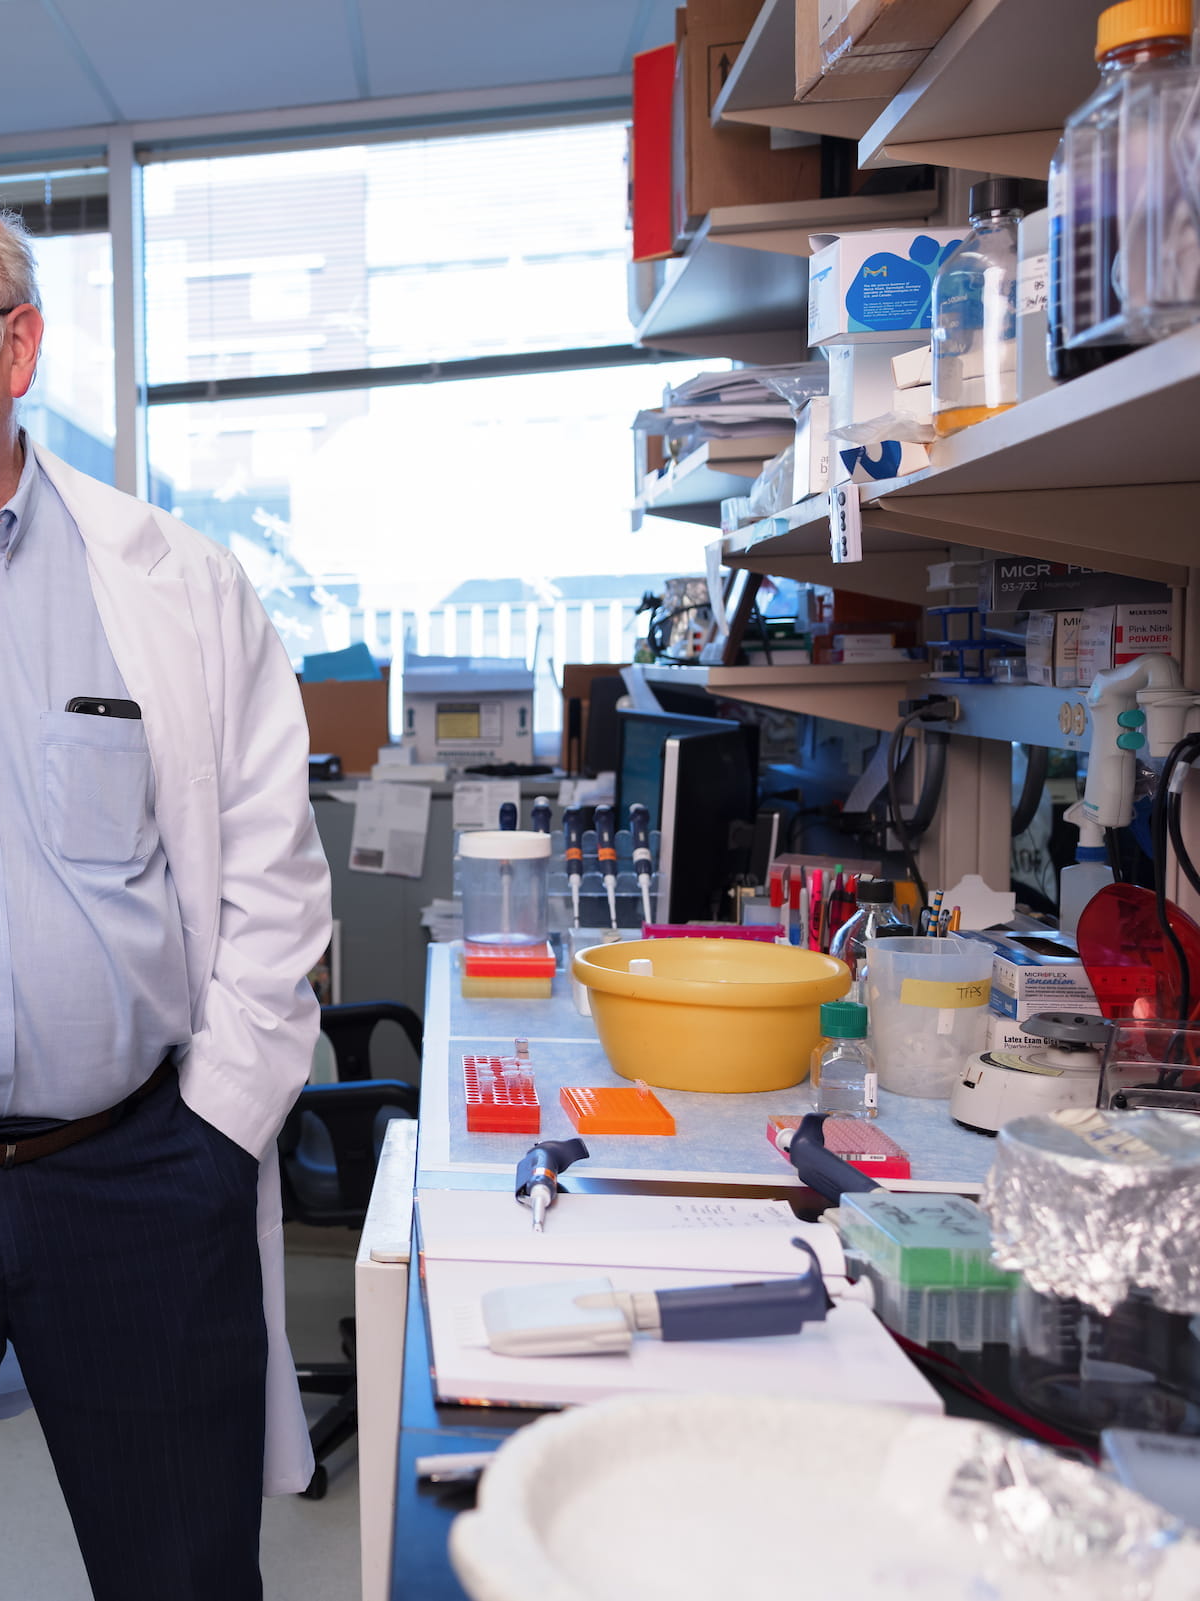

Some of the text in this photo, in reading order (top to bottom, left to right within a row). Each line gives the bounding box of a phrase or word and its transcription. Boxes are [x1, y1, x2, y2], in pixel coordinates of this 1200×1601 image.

[1001, 581, 1038, 592] 93-732
[1004, 1035, 1022, 1044] Latex
[1024, 1036, 1042, 1044] Exam
